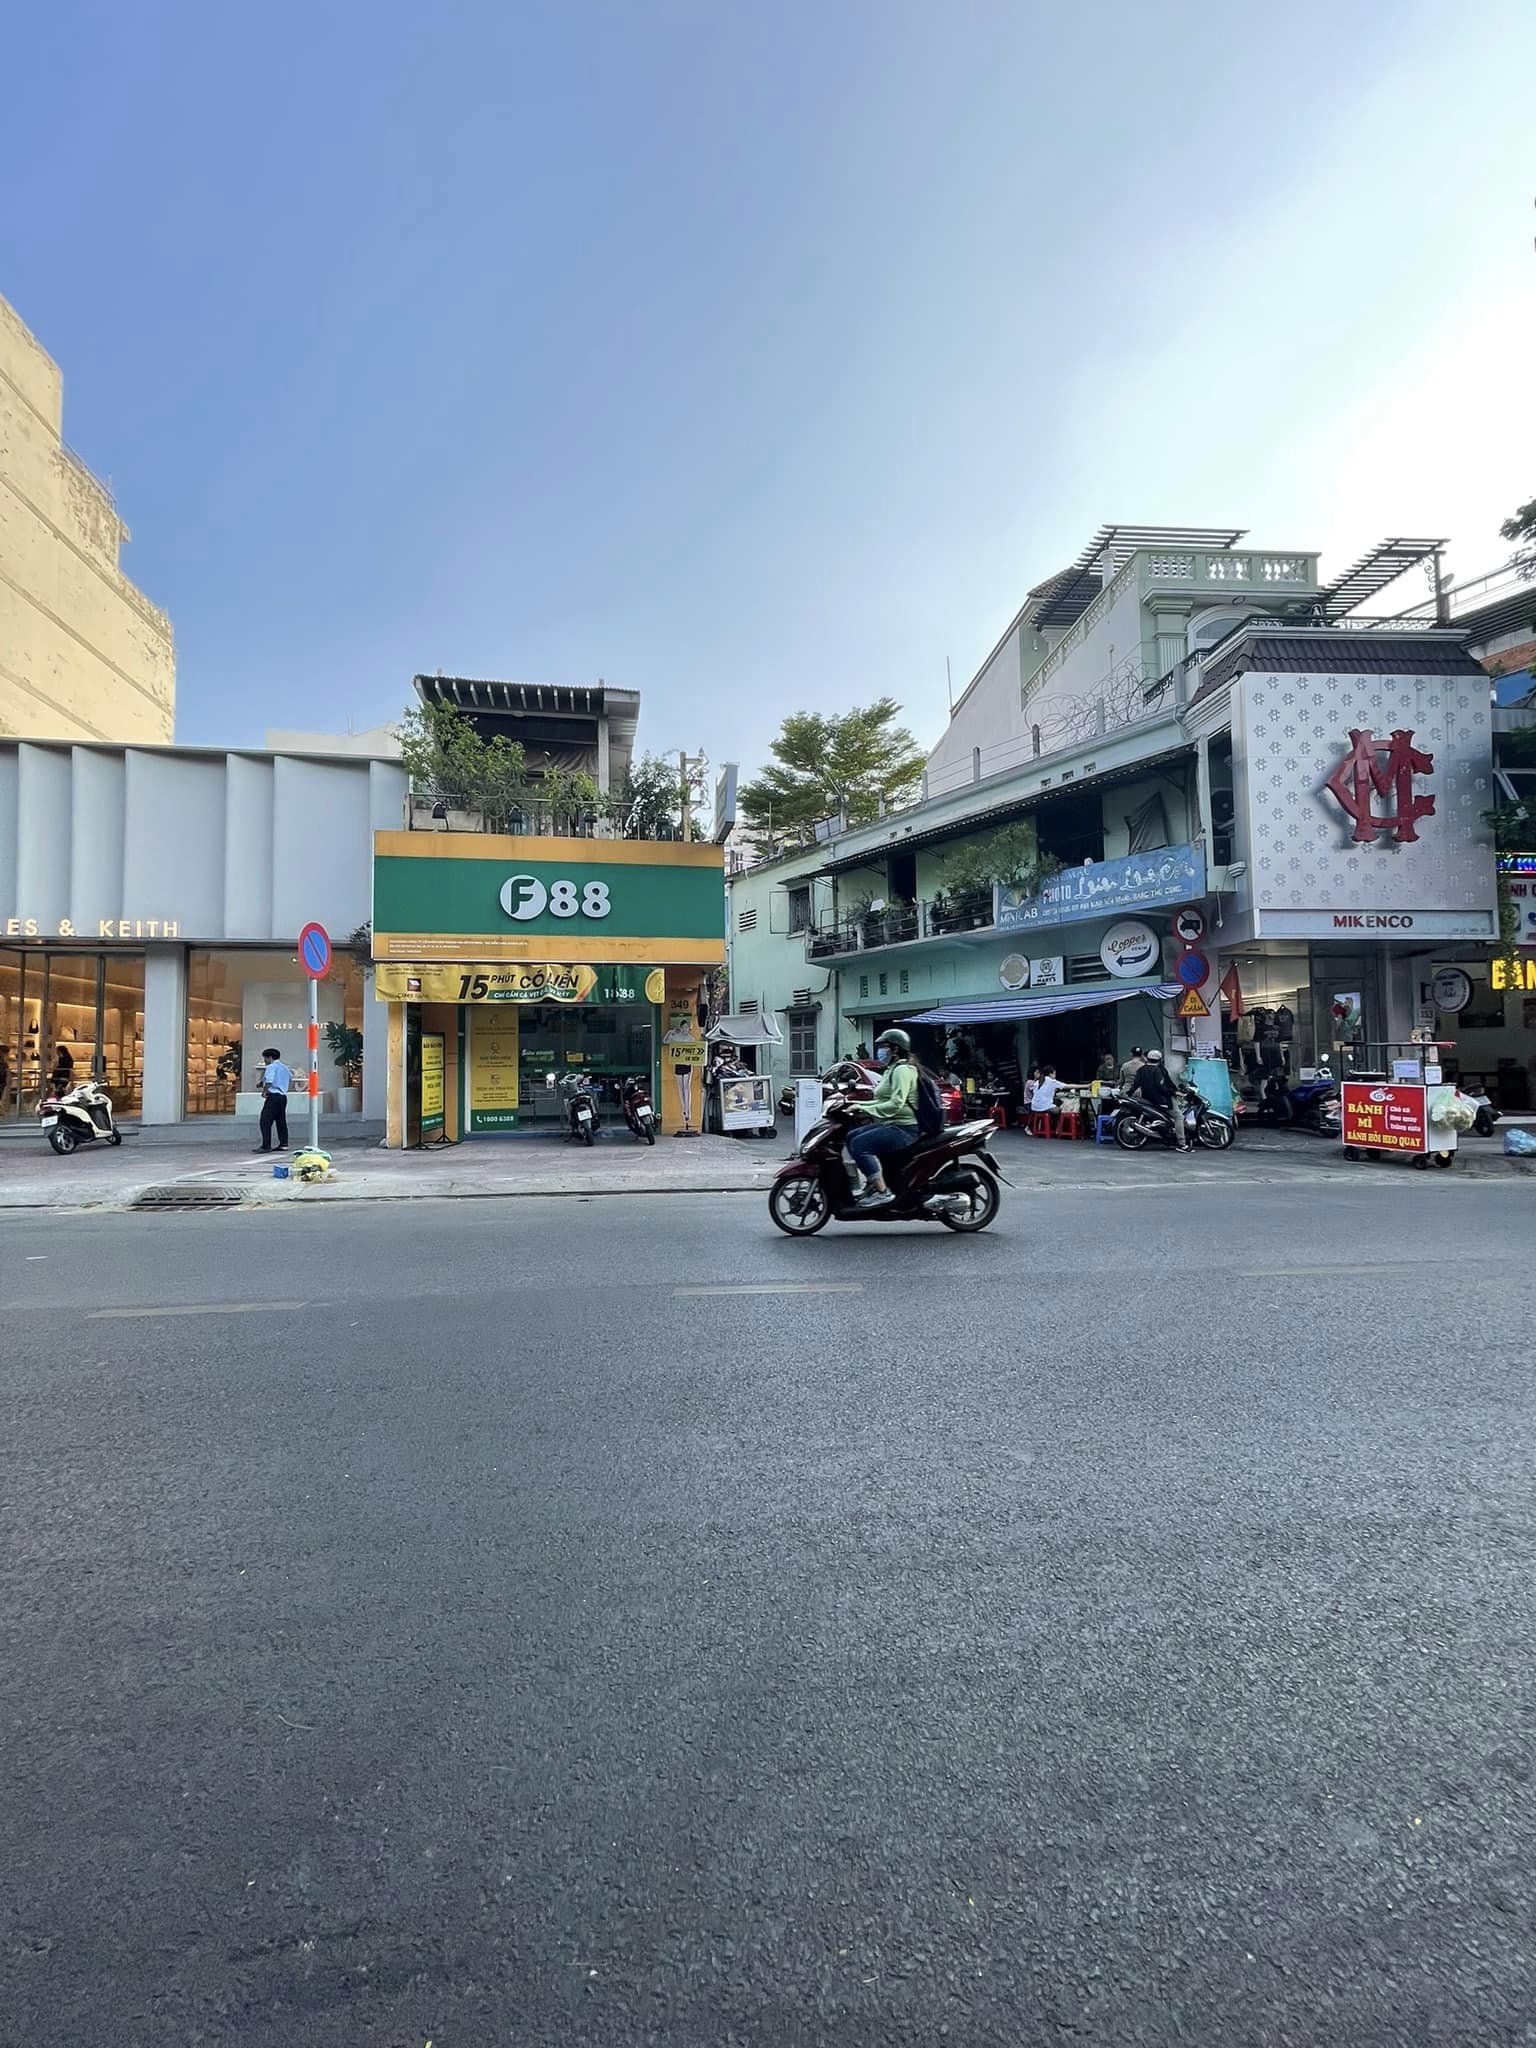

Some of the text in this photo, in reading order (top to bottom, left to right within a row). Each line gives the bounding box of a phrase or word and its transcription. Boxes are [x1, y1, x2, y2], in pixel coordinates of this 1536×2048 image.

[500, 874, 611, 919] F88
[0, 918, 178, 937] ES & KEITH
[1333, 915, 1414, 929] MIKENCO
[459, 974, 490, 1000] 15
[490, 974, 516, 984] PHÚT
[519, 969, 545, 989] CÓ
[1347, 1101, 1383, 1115] BÁNH
[1358, 1116, 1373, 1129] MÌ
[1399, 1136, 1422, 1148] QUAY
